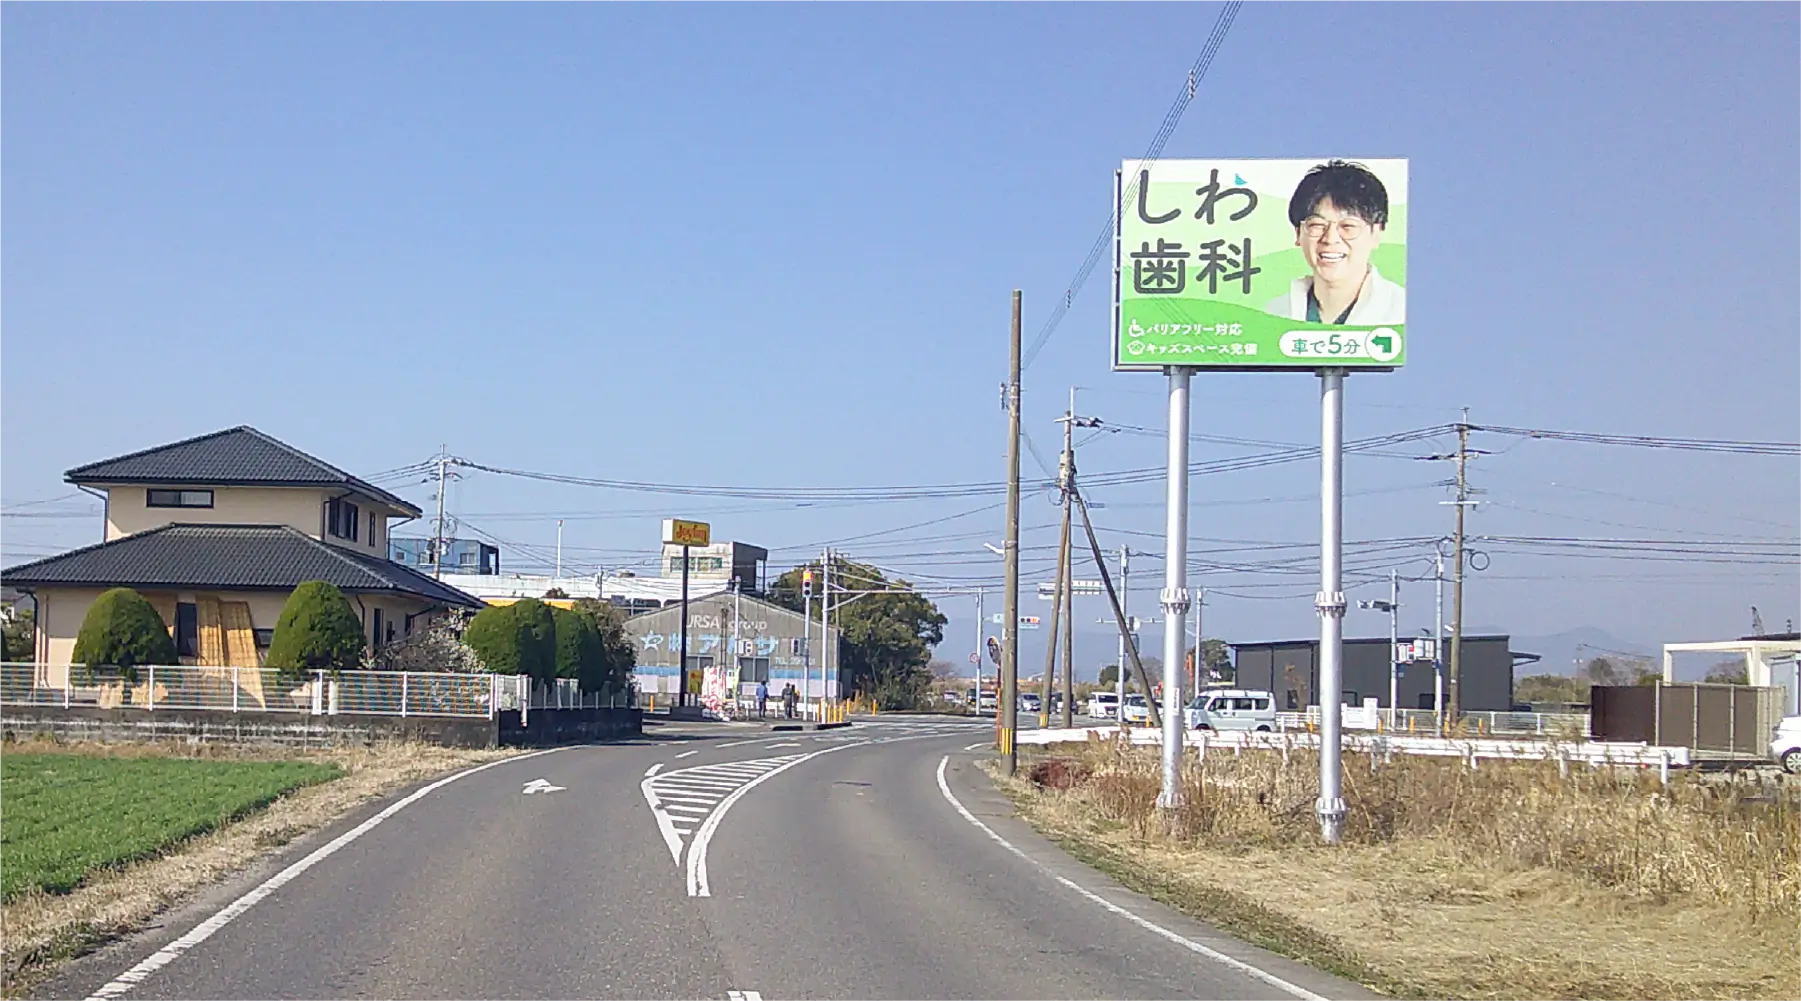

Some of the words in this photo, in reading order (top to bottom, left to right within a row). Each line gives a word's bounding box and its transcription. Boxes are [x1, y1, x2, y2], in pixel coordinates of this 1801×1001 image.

[1138, 168, 1258, 224] しわ
[1130, 237, 1261, 295] 歯科
[1147, 323, 1243, 336] バリアフリー対応
[1292, 334, 1361, 355] 車で5分
